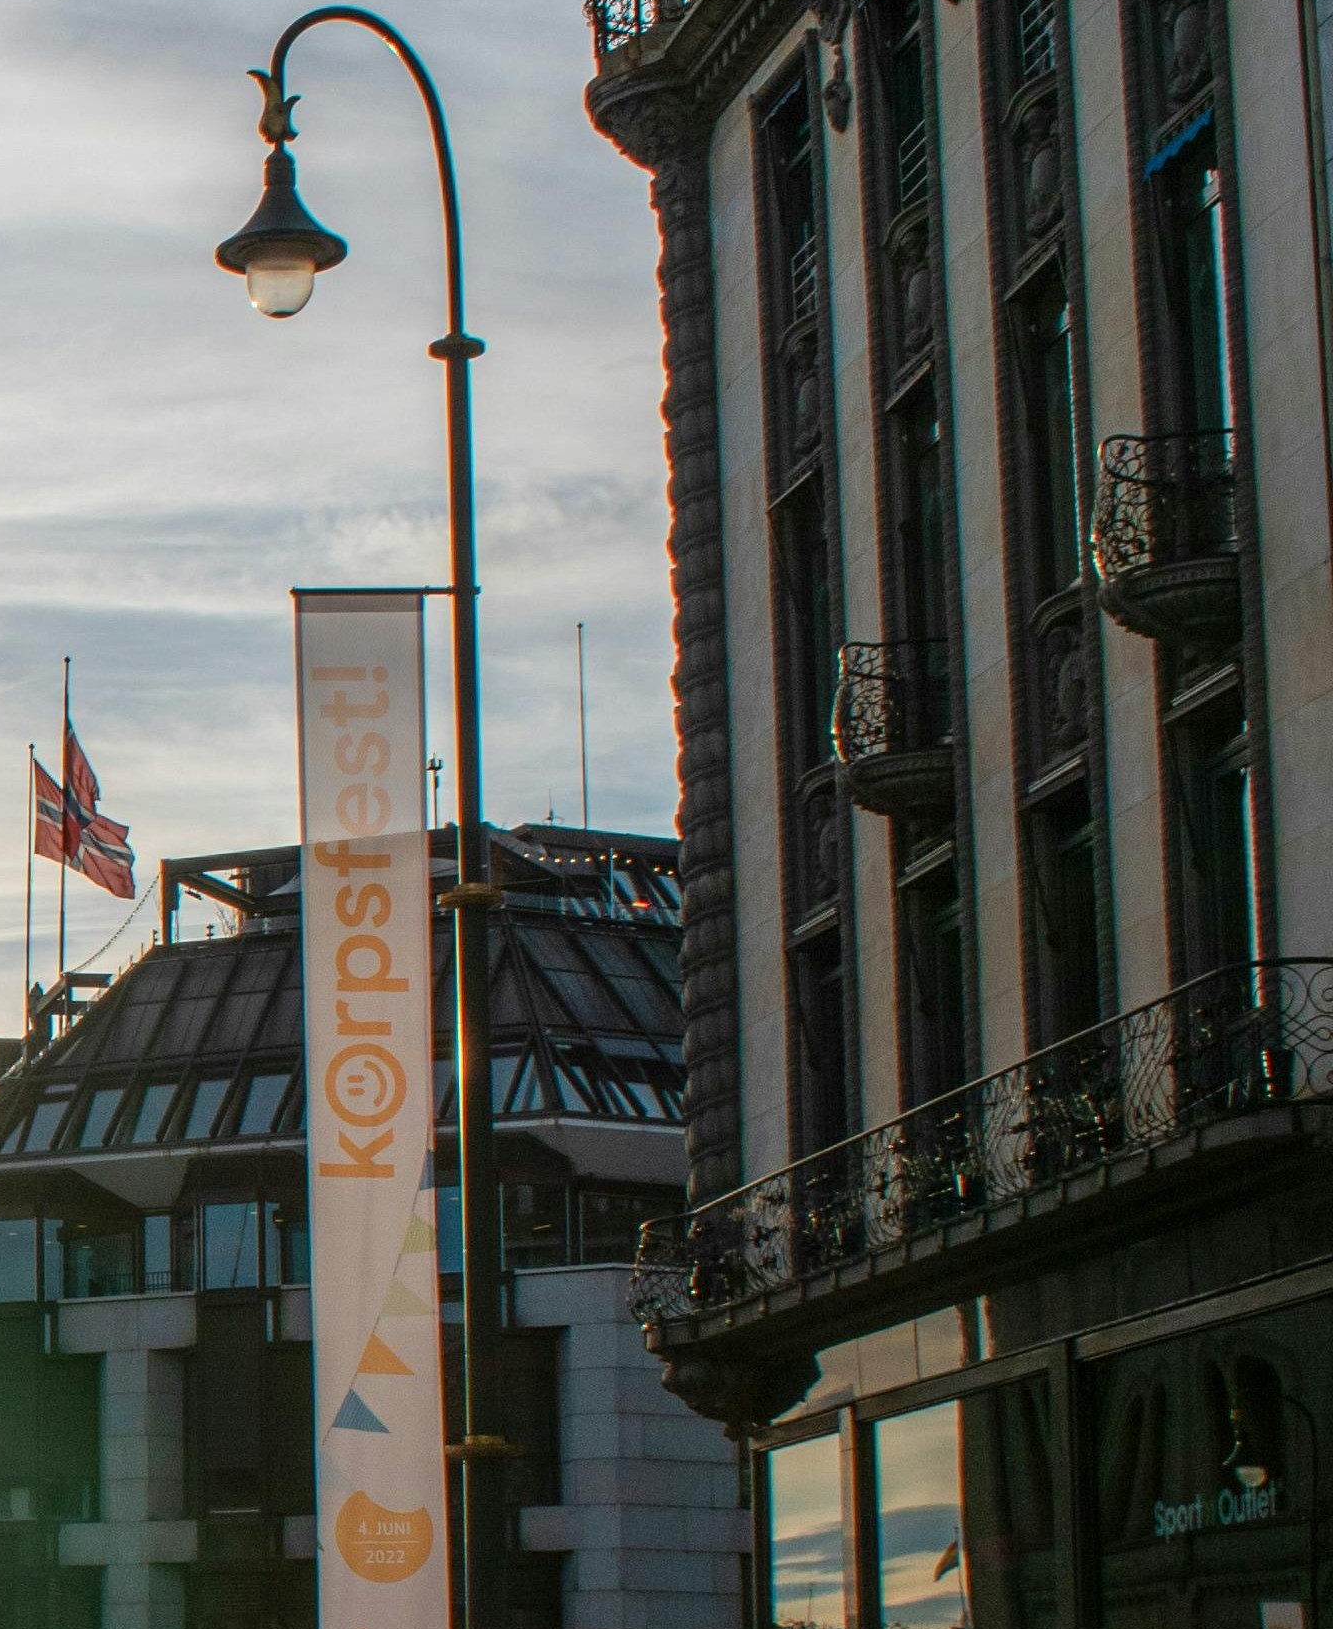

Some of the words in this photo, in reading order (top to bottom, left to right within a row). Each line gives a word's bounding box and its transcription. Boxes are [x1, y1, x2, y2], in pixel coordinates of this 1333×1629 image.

[1153, 1493, 1203, 1544] Sport
[1217, 1479, 1276, 1526] Outlet
[375, 1521, 411, 1535] JUNI
[365, 1549, 405, 1564] 2022
